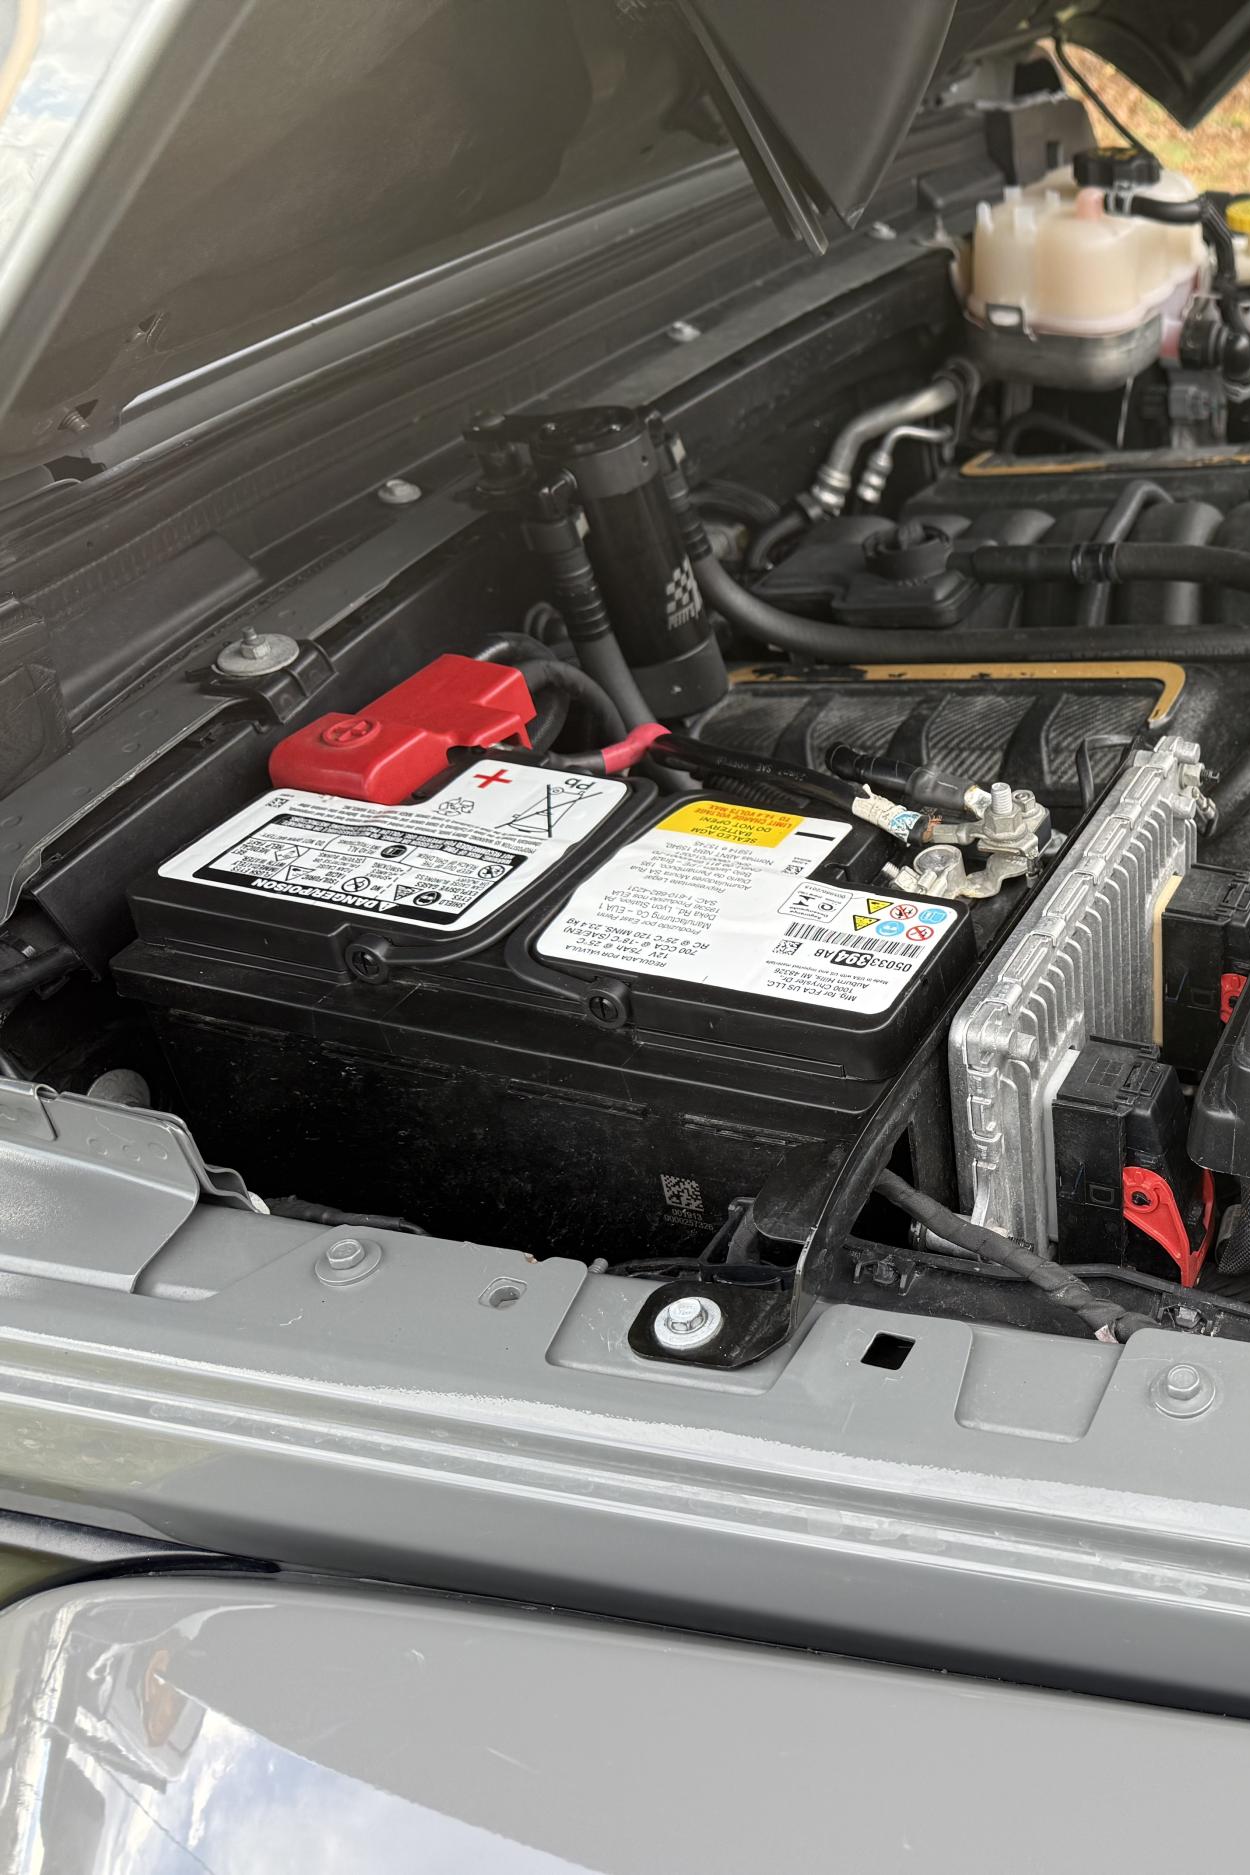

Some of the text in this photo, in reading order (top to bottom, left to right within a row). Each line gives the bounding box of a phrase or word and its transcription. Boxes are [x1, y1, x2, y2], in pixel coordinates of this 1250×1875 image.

[564, 776, 593, 792] Pb
[693, 808, 731, 817] VOLTAGE
[698, 817, 731, 825] OPEN!
[731, 815, 767, 823] CHARGE
[703, 824, 753, 835] BATTERY
[714, 832, 757, 842] SEALED
[692, 847, 714, 856] NBR
[715, 852, 740, 860] ABNT
[232, 860, 279, 872] IMMEDIATELY
[629, 865, 648, 873] Rua
[249, 869, 272, 878] FLUSH
[663, 871, 691, 880] Moura
[301, 874, 337, 884] SULFURIC
[251, 878, 381, 907] DANGER/POISON
[414, 881, 478, 897] EXPLOSIVE GASES
[611, 889, 632, 898] EUA
[438, 899, 465, 909] SHIELD
[606, 903, 626, 914] EUA
[651, 903, 673, 913] Lyon
[693, 903, 720, 914] 19536
[596, 911, 619, 921] Penn
[619, 915, 641, 925] East
[651, 911, 712, 930] Manufacturing
[693, 910, 717, 921] Deka
[566, 918, 580, 926] kg
[580, 922, 602, 930] 23.4
[563, 926, 611, 940] (SAE/EN)
[605, 926, 633, 936] MINS.
[657, 923, 701, 935] Produzido
[610, 935, 639, 945] -18°C
[633, 931, 651, 939] 120
[653, 935, 679, 944] 25°C
[576, 937, 602, 947] 25°C
[692, 942, 710, 950] RC
[616, 945, 642, 955] 75Ah
[654, 943, 677, 952] CCA
[678, 947, 698, 956] 700
[601, 951, 620, 959] POR
[648, 951, 669, 959] 12V
[621, 955, 667, 968] REGULADA
[774, 967, 800, 977] 48326
[787, 984, 801, 992] US
[794, 978, 832, 990] Chrysler
[837, 979, 870, 989] Auburn
[803, 987, 823, 996] FCA
[832, 985, 853, 994] 1000
[839, 992, 857, 1002] Mfg.
